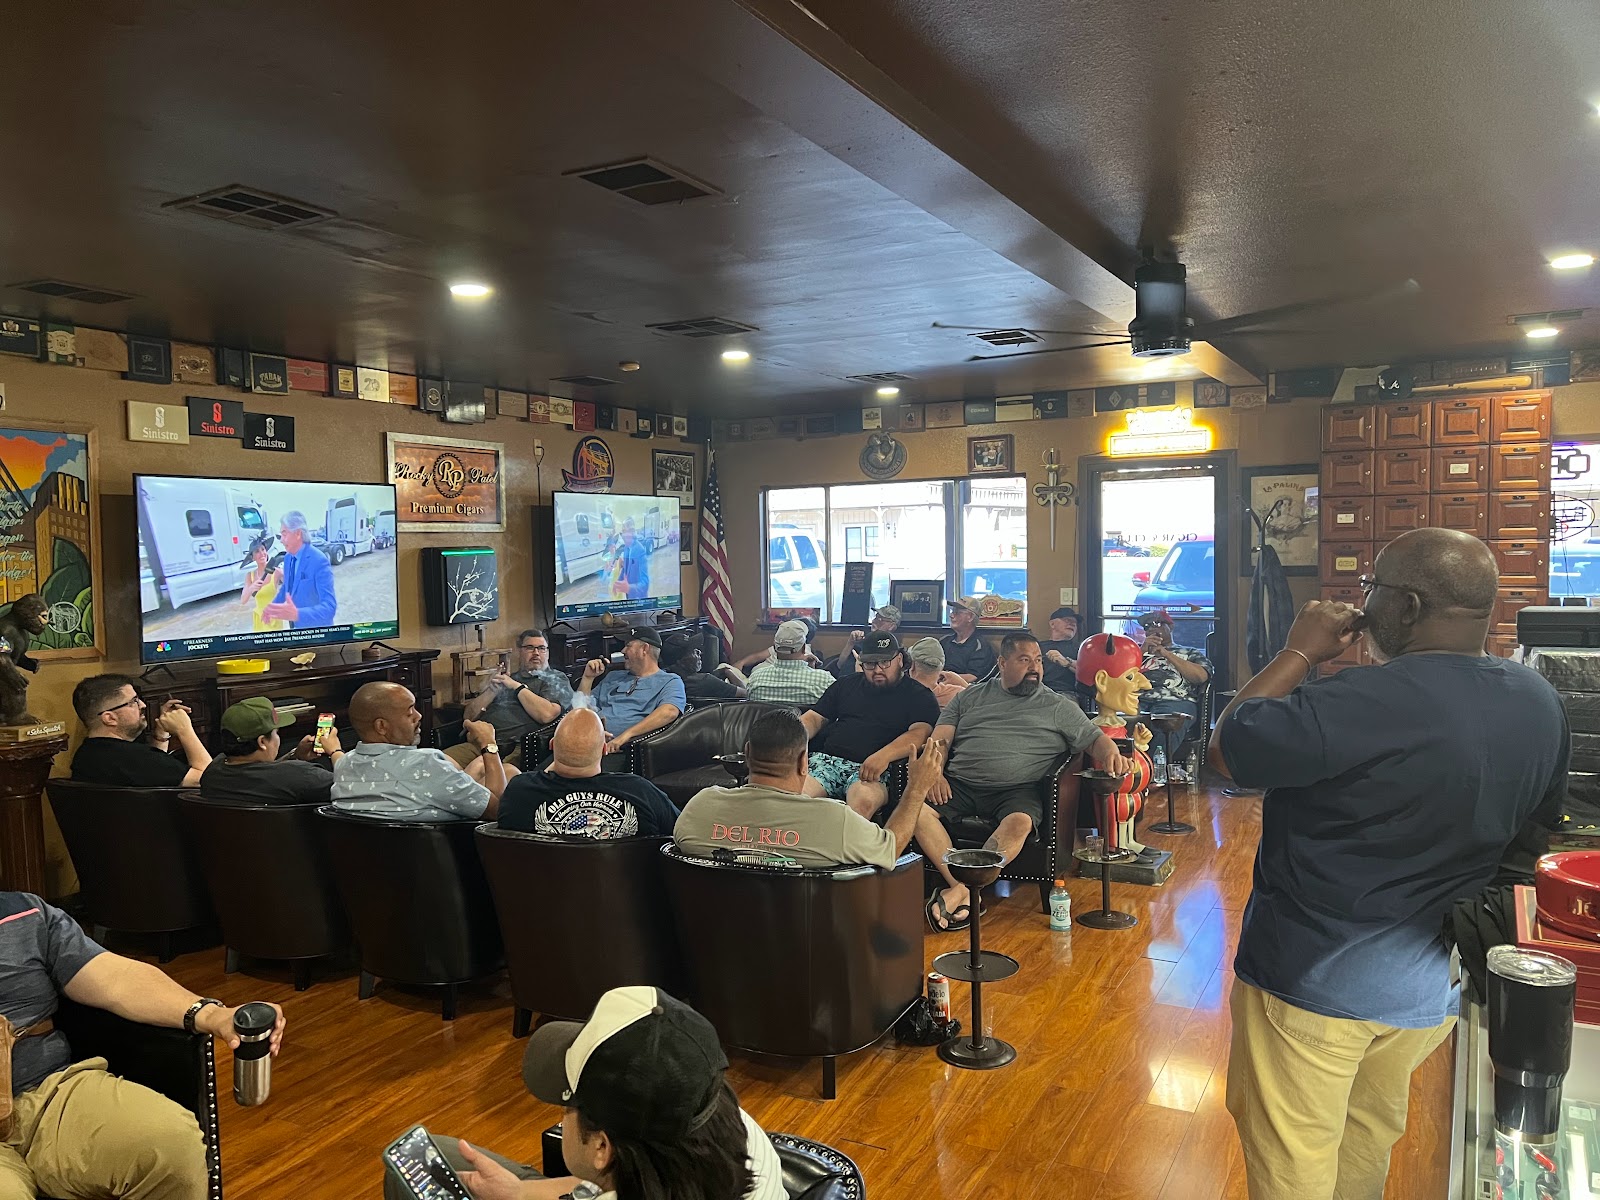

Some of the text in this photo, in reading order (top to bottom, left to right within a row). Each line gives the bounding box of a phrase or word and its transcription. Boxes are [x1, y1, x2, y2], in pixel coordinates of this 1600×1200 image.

[142, 427, 179, 441] Sinistro
[201, 422, 235, 435] Sinistro
[254, 435, 287, 449] Sinistro
[394, 462, 499, 487] Rocky Patel
[411, 501, 484, 517] Premium Cigars
[548, 792, 623, 814] OLD GUYS RULE
[710, 823, 800, 847] DEL RIO
